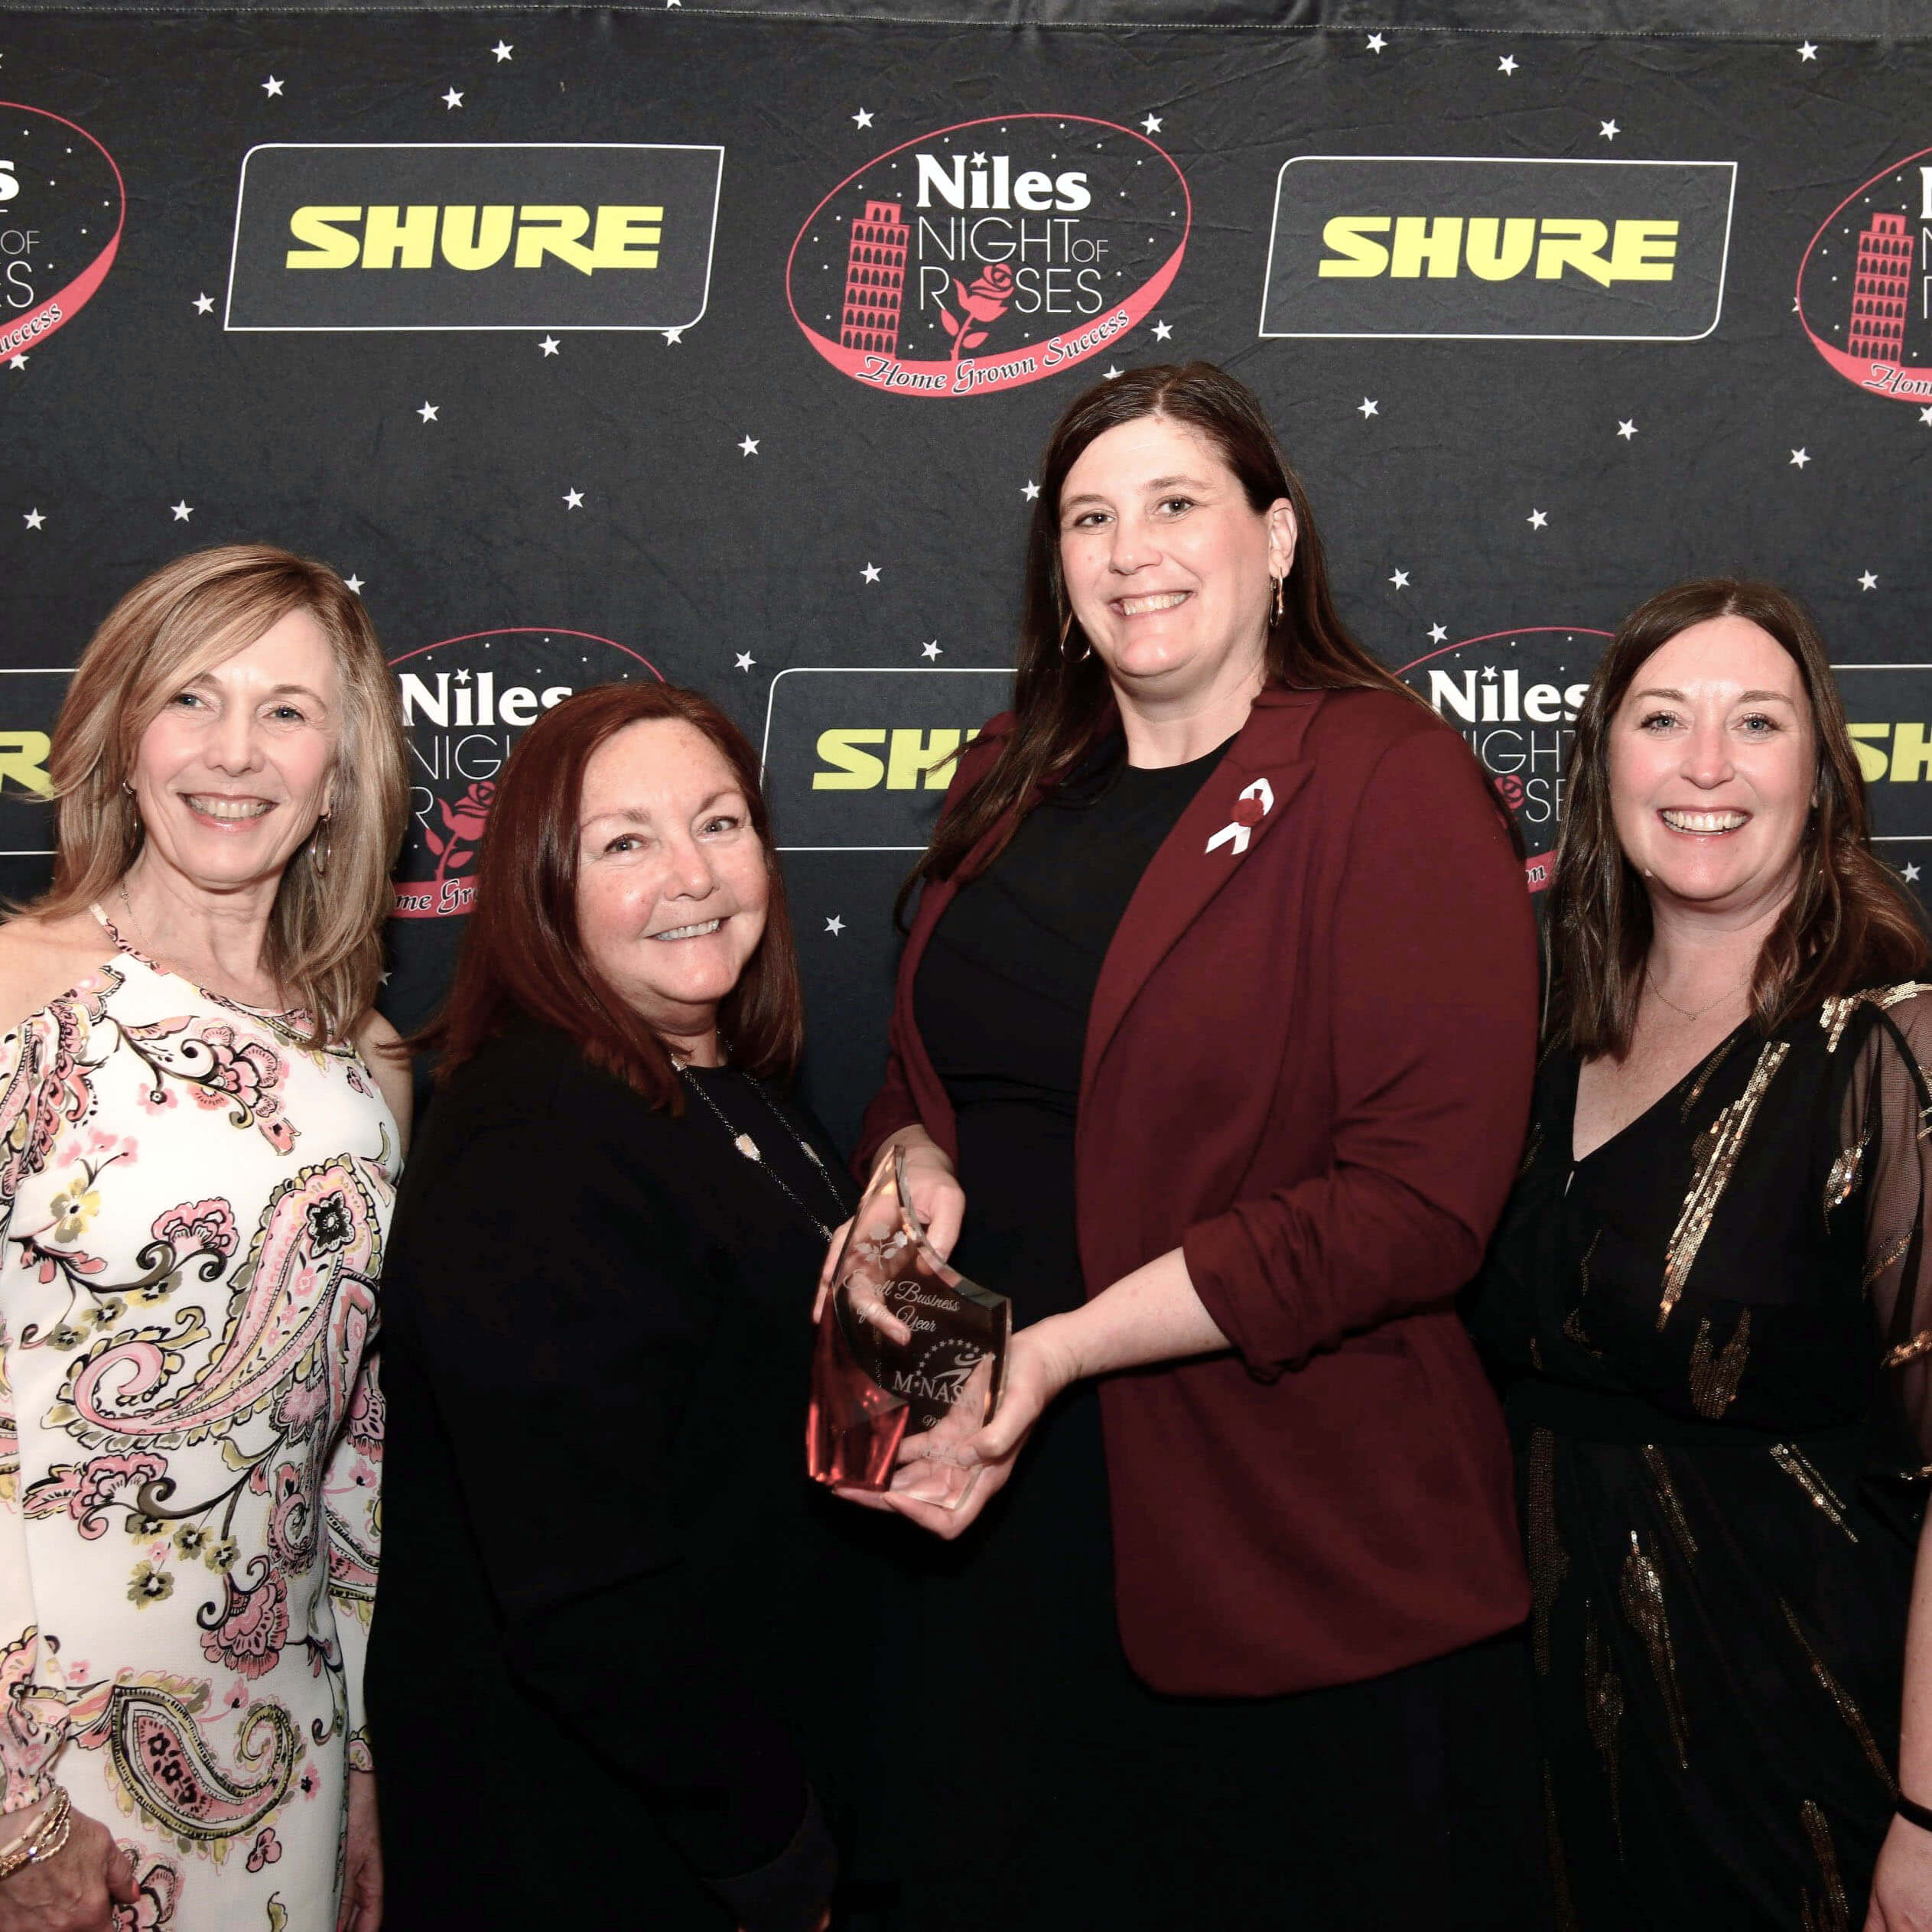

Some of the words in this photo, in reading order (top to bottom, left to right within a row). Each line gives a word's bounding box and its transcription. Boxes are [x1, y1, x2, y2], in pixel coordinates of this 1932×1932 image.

[916, 151, 1091, 212] Niles
[1, 229, 41, 255] OF
[285, 205, 664, 277] SHURE
[919, 216, 1079, 262] NIGHT
[1072, 239, 1109, 263] OF
[1318, 216, 1679, 288] SHURE
[0, 304, 63, 356] uccess
[856, 355, 947, 390] Home
[952, 358, 1037, 395] Grown
[1043, 309, 1129, 367] Success
[1862, 363, 1932, 397] Hom
[894, 1280, 961, 1312] Business
[896, 1305, 938, 1332] Year
